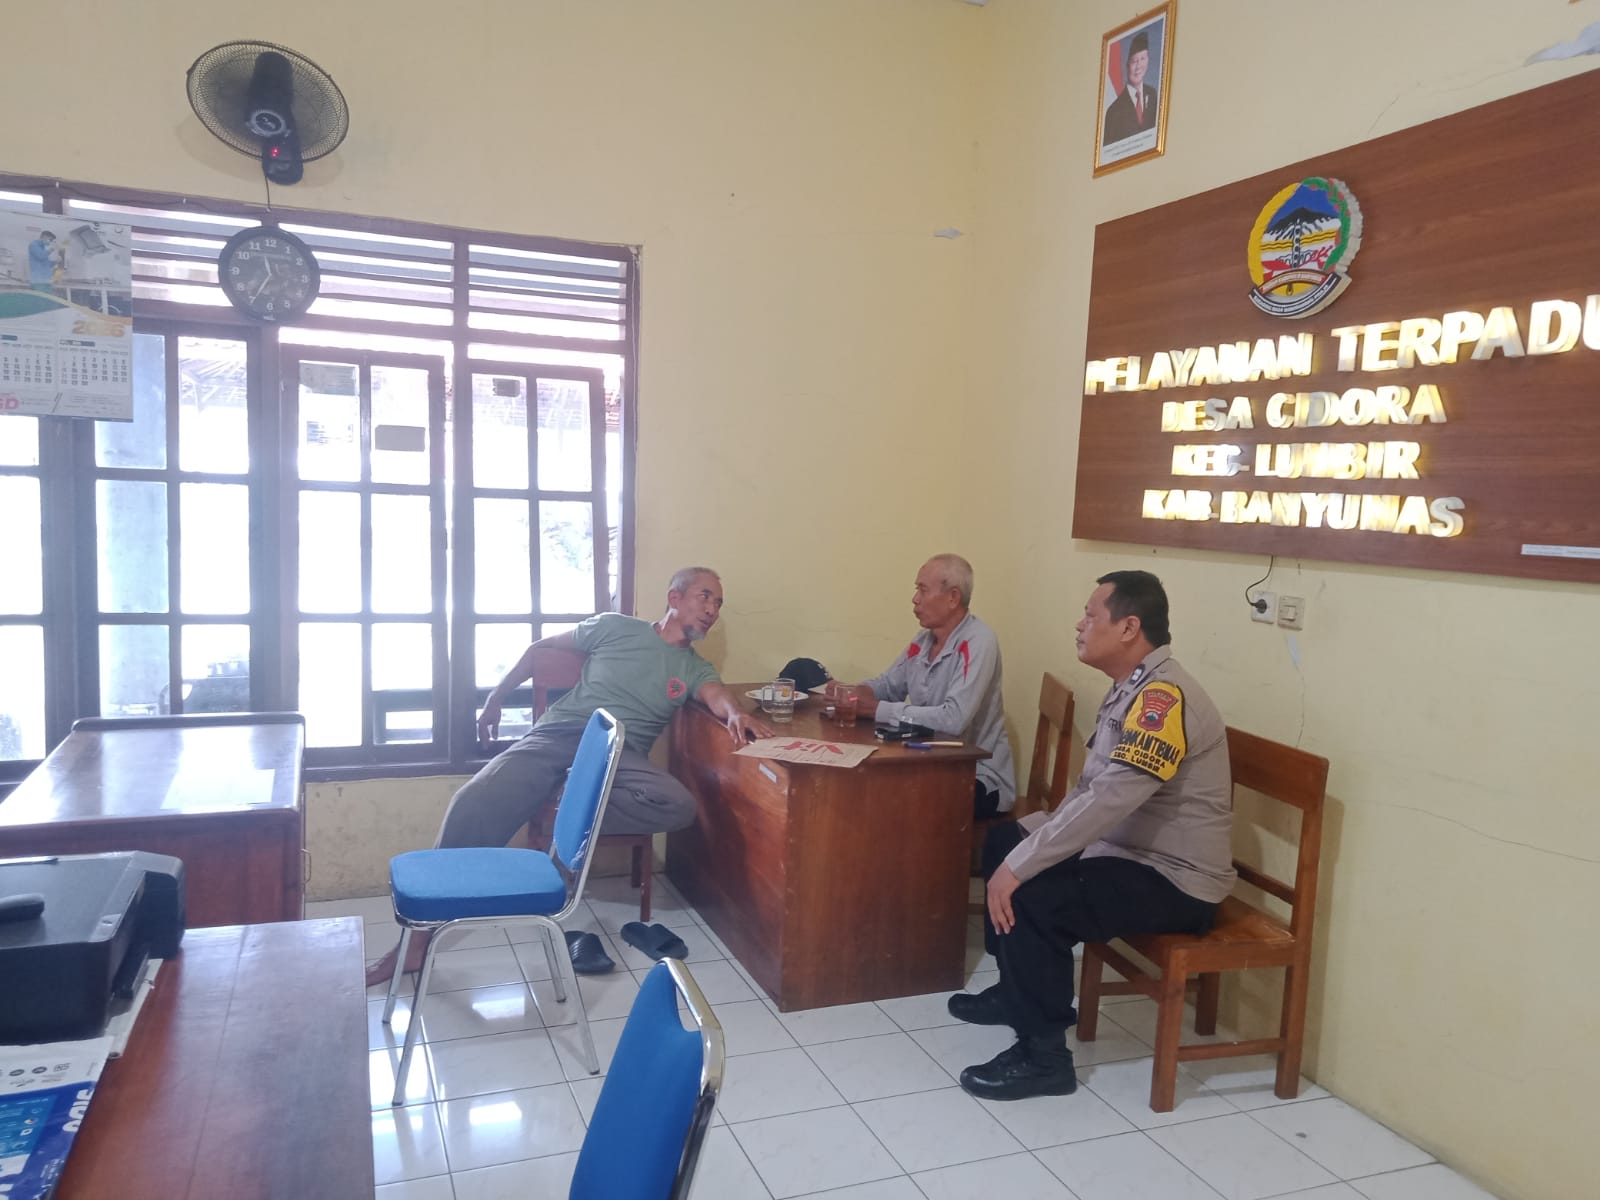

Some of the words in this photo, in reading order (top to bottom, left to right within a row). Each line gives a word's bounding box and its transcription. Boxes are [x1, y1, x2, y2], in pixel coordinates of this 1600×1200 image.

[249, 241, 261, 251] 11
[265, 239, 277, 248] 12
[237, 251, 250, 260] 10
[232, 266, 240, 275] 9
[266, 302, 274, 311] 6
[1084, 332, 1314, 395] PELAYANAN
[1161, 396, 1254, 433] DESA
[1266, 384, 1447, 428] CIDORA
[1255, 441, 1420, 480] LUMBIR
[1220, 490, 1465, 538] BANYUMAS
